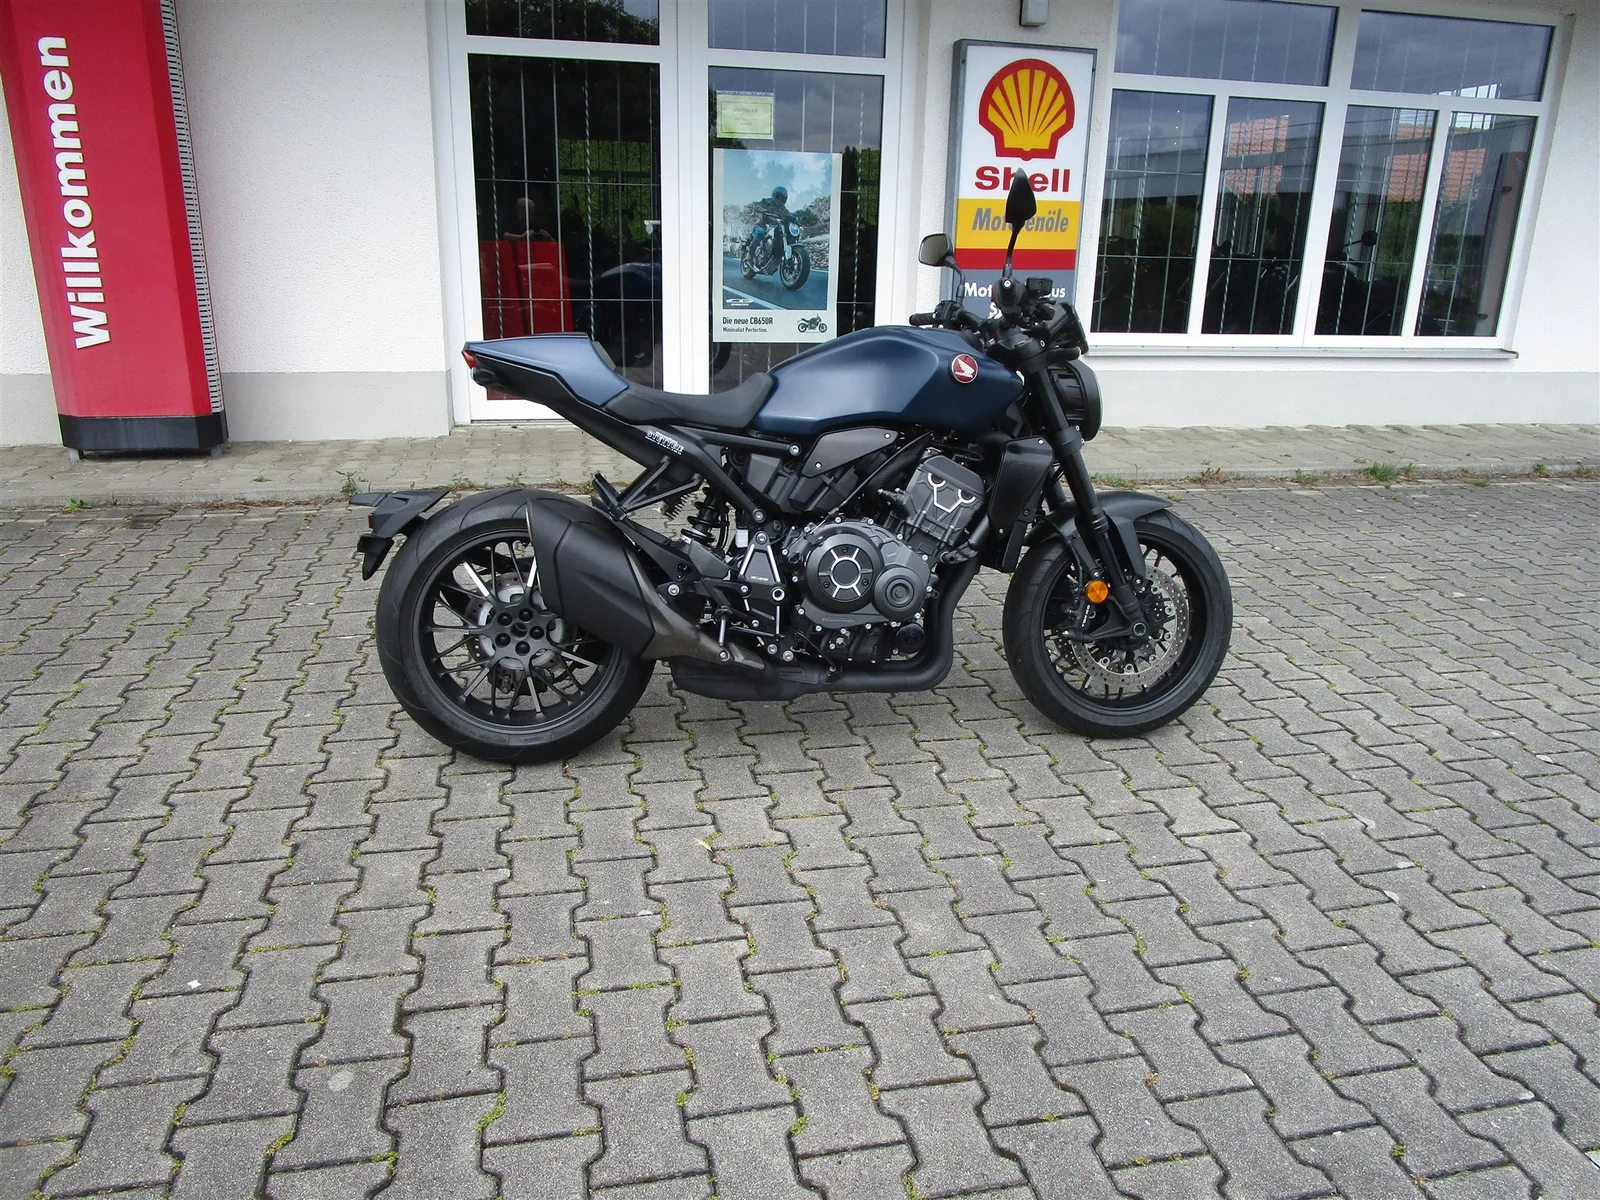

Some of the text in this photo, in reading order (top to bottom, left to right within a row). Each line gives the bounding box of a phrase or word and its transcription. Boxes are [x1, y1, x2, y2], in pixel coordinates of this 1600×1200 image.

[38, 36, 111, 350] Willkommen
[972, 208, 1069, 233] Motenöle
[722, 316, 732, 325] Die
[750, 316, 773, 325] CB650R
